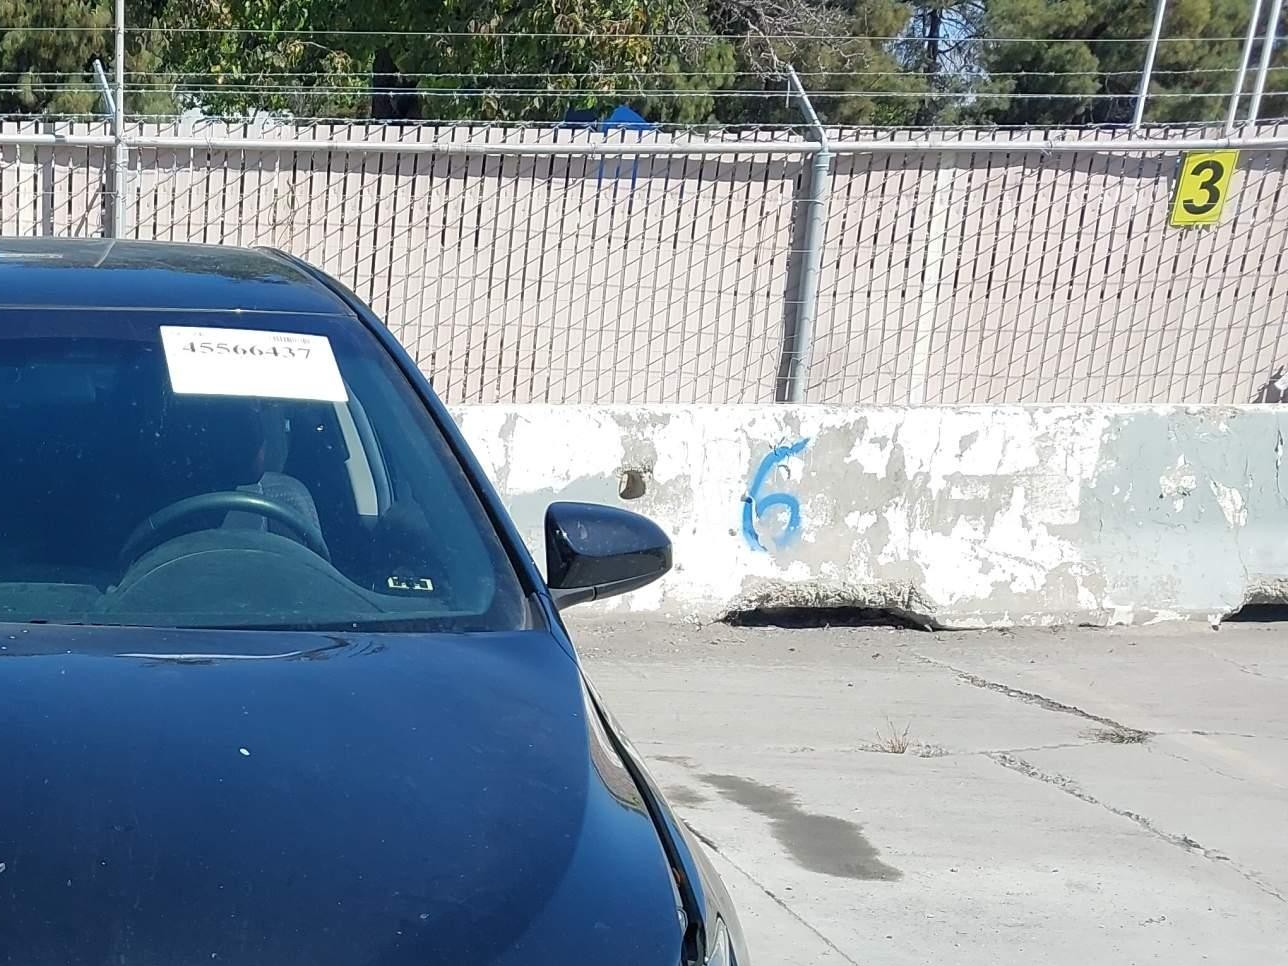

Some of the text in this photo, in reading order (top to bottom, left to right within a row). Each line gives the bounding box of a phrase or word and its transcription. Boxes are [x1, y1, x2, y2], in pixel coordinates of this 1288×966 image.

[1182, 159, 1225, 215] 3
[182, 341, 311, 359] 45566437
[742, 438, 811, 551] 6
